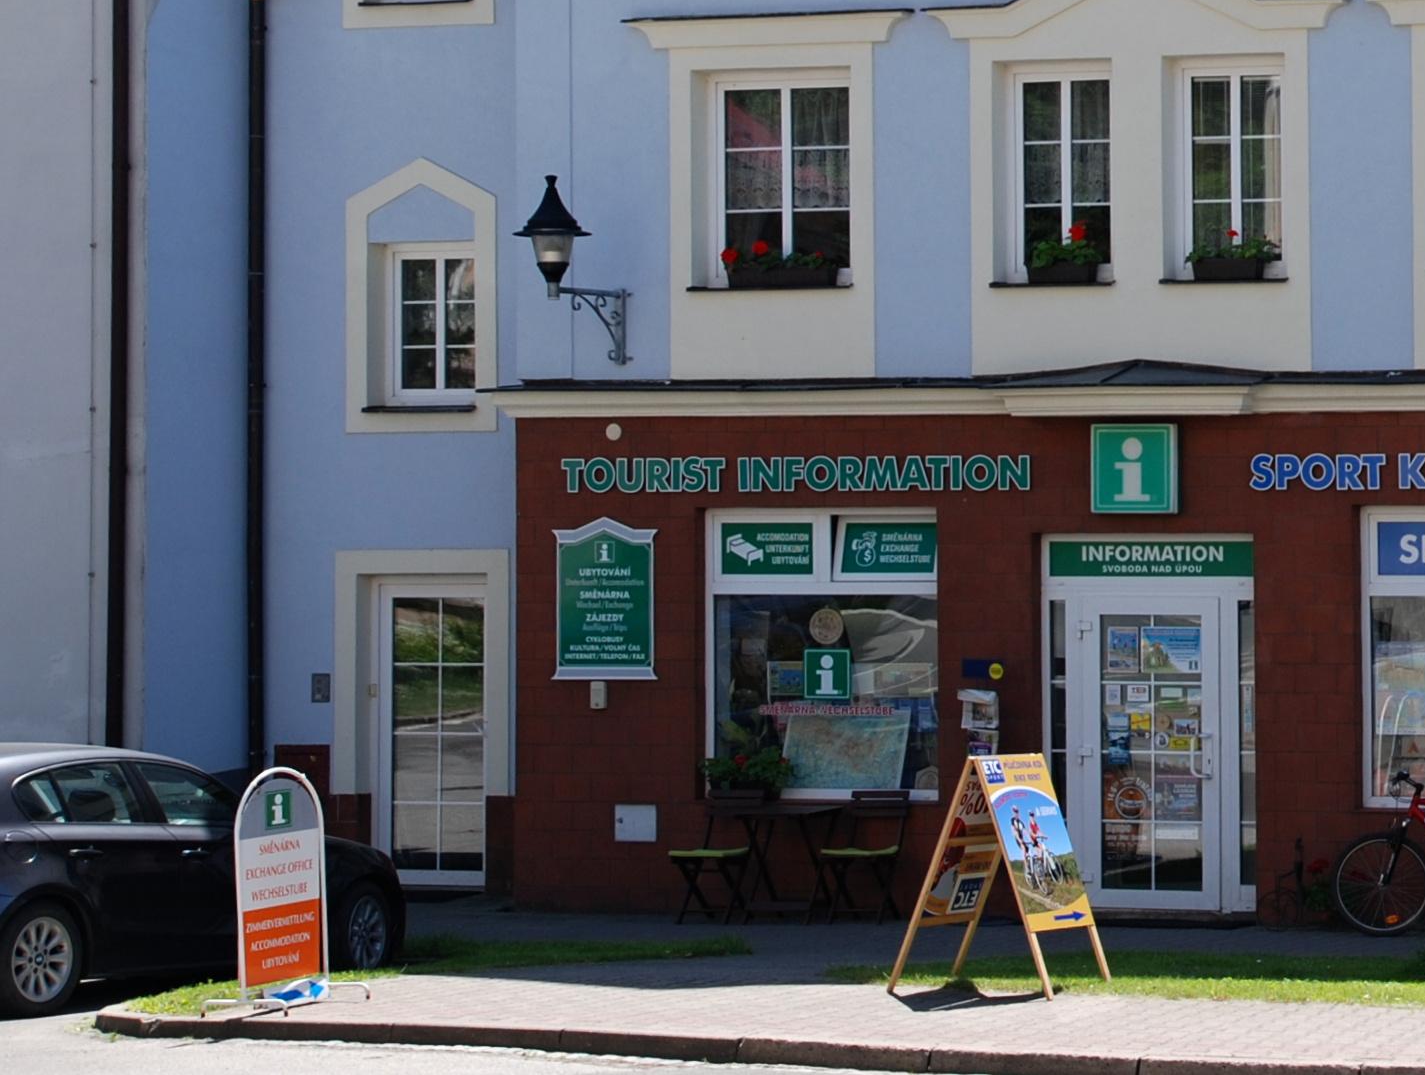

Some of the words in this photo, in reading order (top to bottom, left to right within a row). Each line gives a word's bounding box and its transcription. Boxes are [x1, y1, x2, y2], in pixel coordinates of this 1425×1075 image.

[561, 457, 725, 493] TOURIST
[738, 454, 1030, 492] INFORMATION
[1250, 453, 1386, 491] SPORT
[765, 544, 809, 553] UNTERKUNFT
[880, 544, 919, 553] EXCHANGE
[1081, 545, 1224, 562] INFORMATION
[771, 554, 810, 565] UBYTOVÁNÍ
[879, 554, 931, 564] WECHSELSTUBE
[578, 567, 631, 577] UBYTOVÁNÍ
[1102, 565, 1148, 573] SVOBODA
[1151, 565, 1172, 573] NAD
[1175, 563, 1202, 573] ÚPOU
[579, 588, 630, 599] SMĚNÁRNA
[586, 612, 624, 622] ZÁJEZDY
[982, 760, 1003, 774] ETC
[246, 864, 286, 880] EXCHANGE
[288, 859, 313, 874] OFFICE
[252, 882, 308, 901] WECHSELSTUBE
